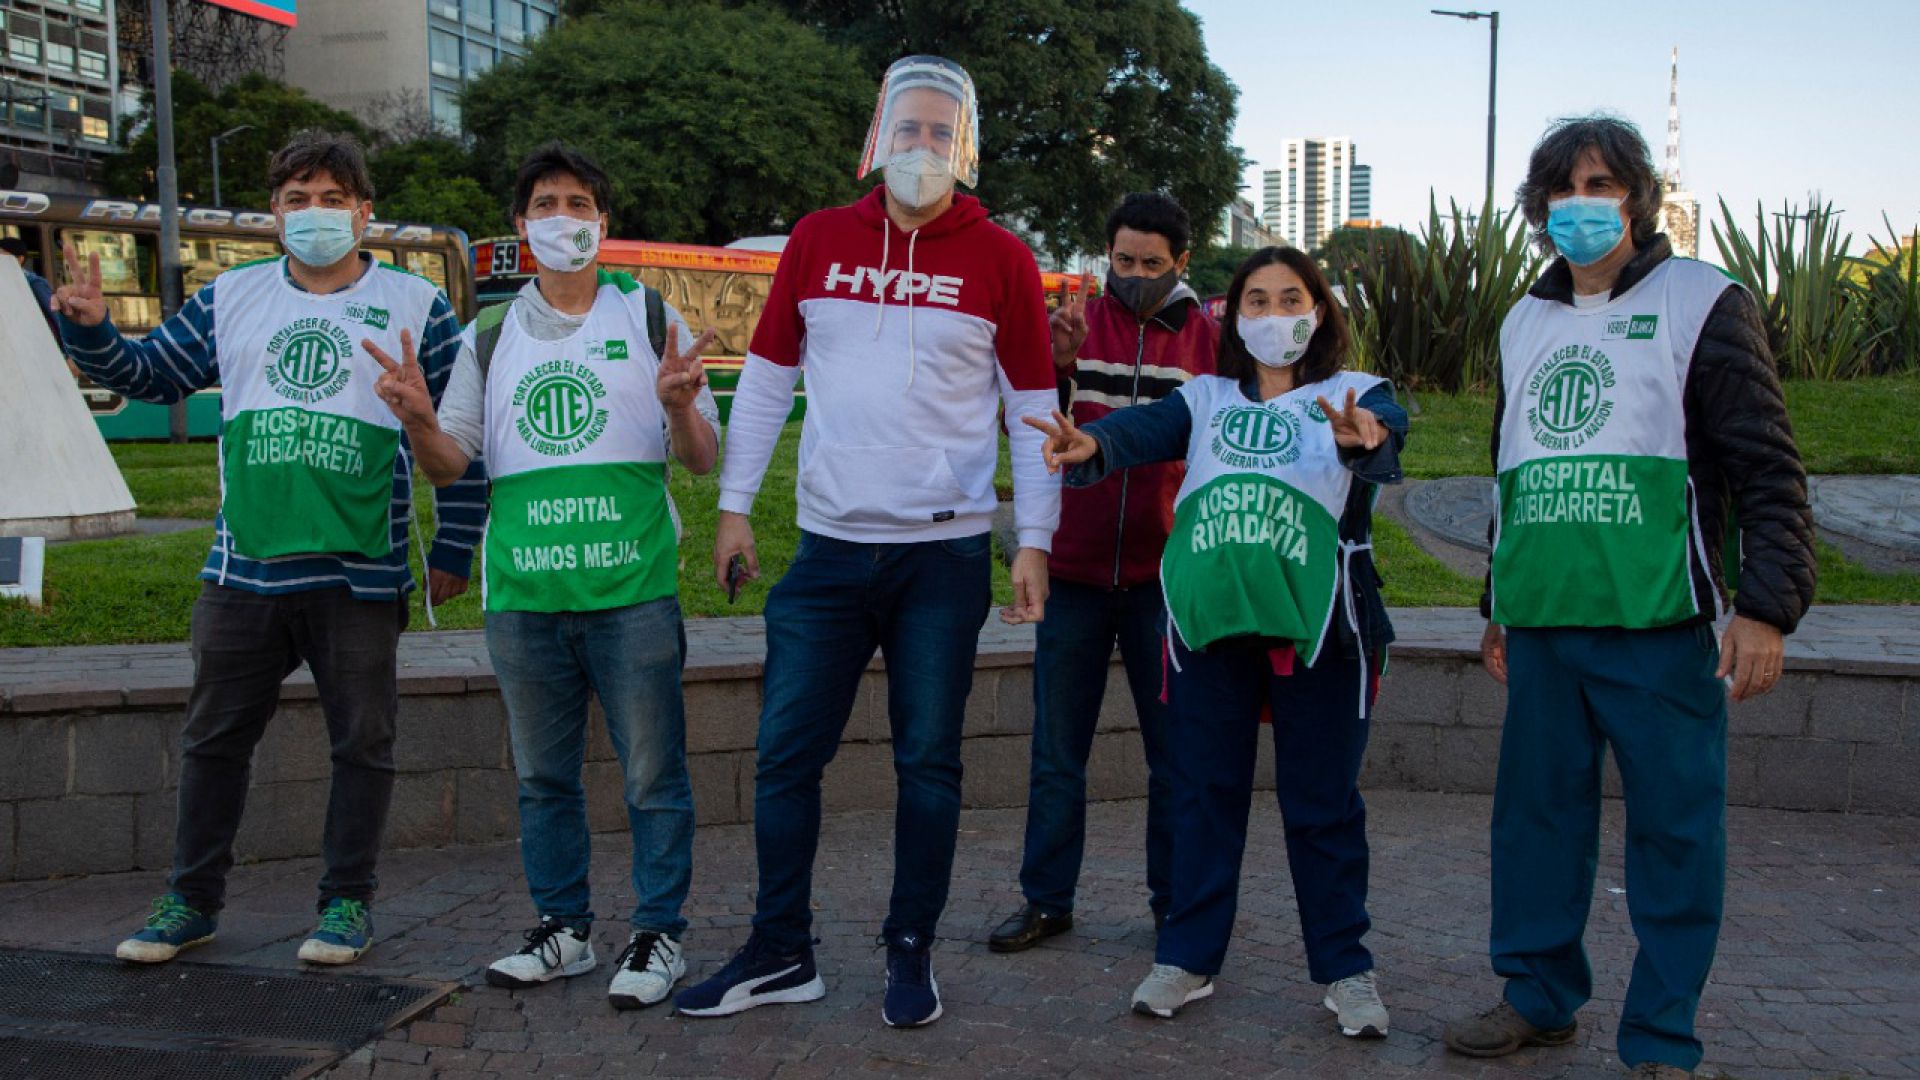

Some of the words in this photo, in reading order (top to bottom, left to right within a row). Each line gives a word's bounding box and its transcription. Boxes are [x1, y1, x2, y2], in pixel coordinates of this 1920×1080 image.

[494, 244, 517, 271] 59
[824, 262, 964, 307] HYPE
[266, 317, 319, 355] FORTALECER
[283, 335, 331, 384] ATE
[1527, 344, 1579, 396] FORTALECER
[512, 360, 561, 406] FORTALECER
[564, 360, 574, 374] EL
[576, 364, 607, 398] ESTADO
[1543, 368, 1594, 426] ATE
[252, 409, 362, 449] HOSPITAL
[532, 382, 585, 435] ATE
[1227, 410, 1284, 449] ATE
[1573, 433, 1585, 449] LA
[1584, 400, 1615, 440] NACION
[530, 437, 571, 457] LIBERAR
[571, 438, 586, 453] LA
[583, 409, 610, 445] NACION
[1220, 448, 1260, 469] LIBERAR
[1262, 455, 1276, 469] LA
[1519, 461, 1636, 493] HOSPITAL
[527, 495, 622, 526] HOSPITAL
[1198, 482, 1307, 534] HOSPITAL
[1513, 491, 1643, 526] ZUBIZARRETA
[512, 543, 577, 572] RAMOS
[1191, 512, 1309, 567] RIVADAVIA
